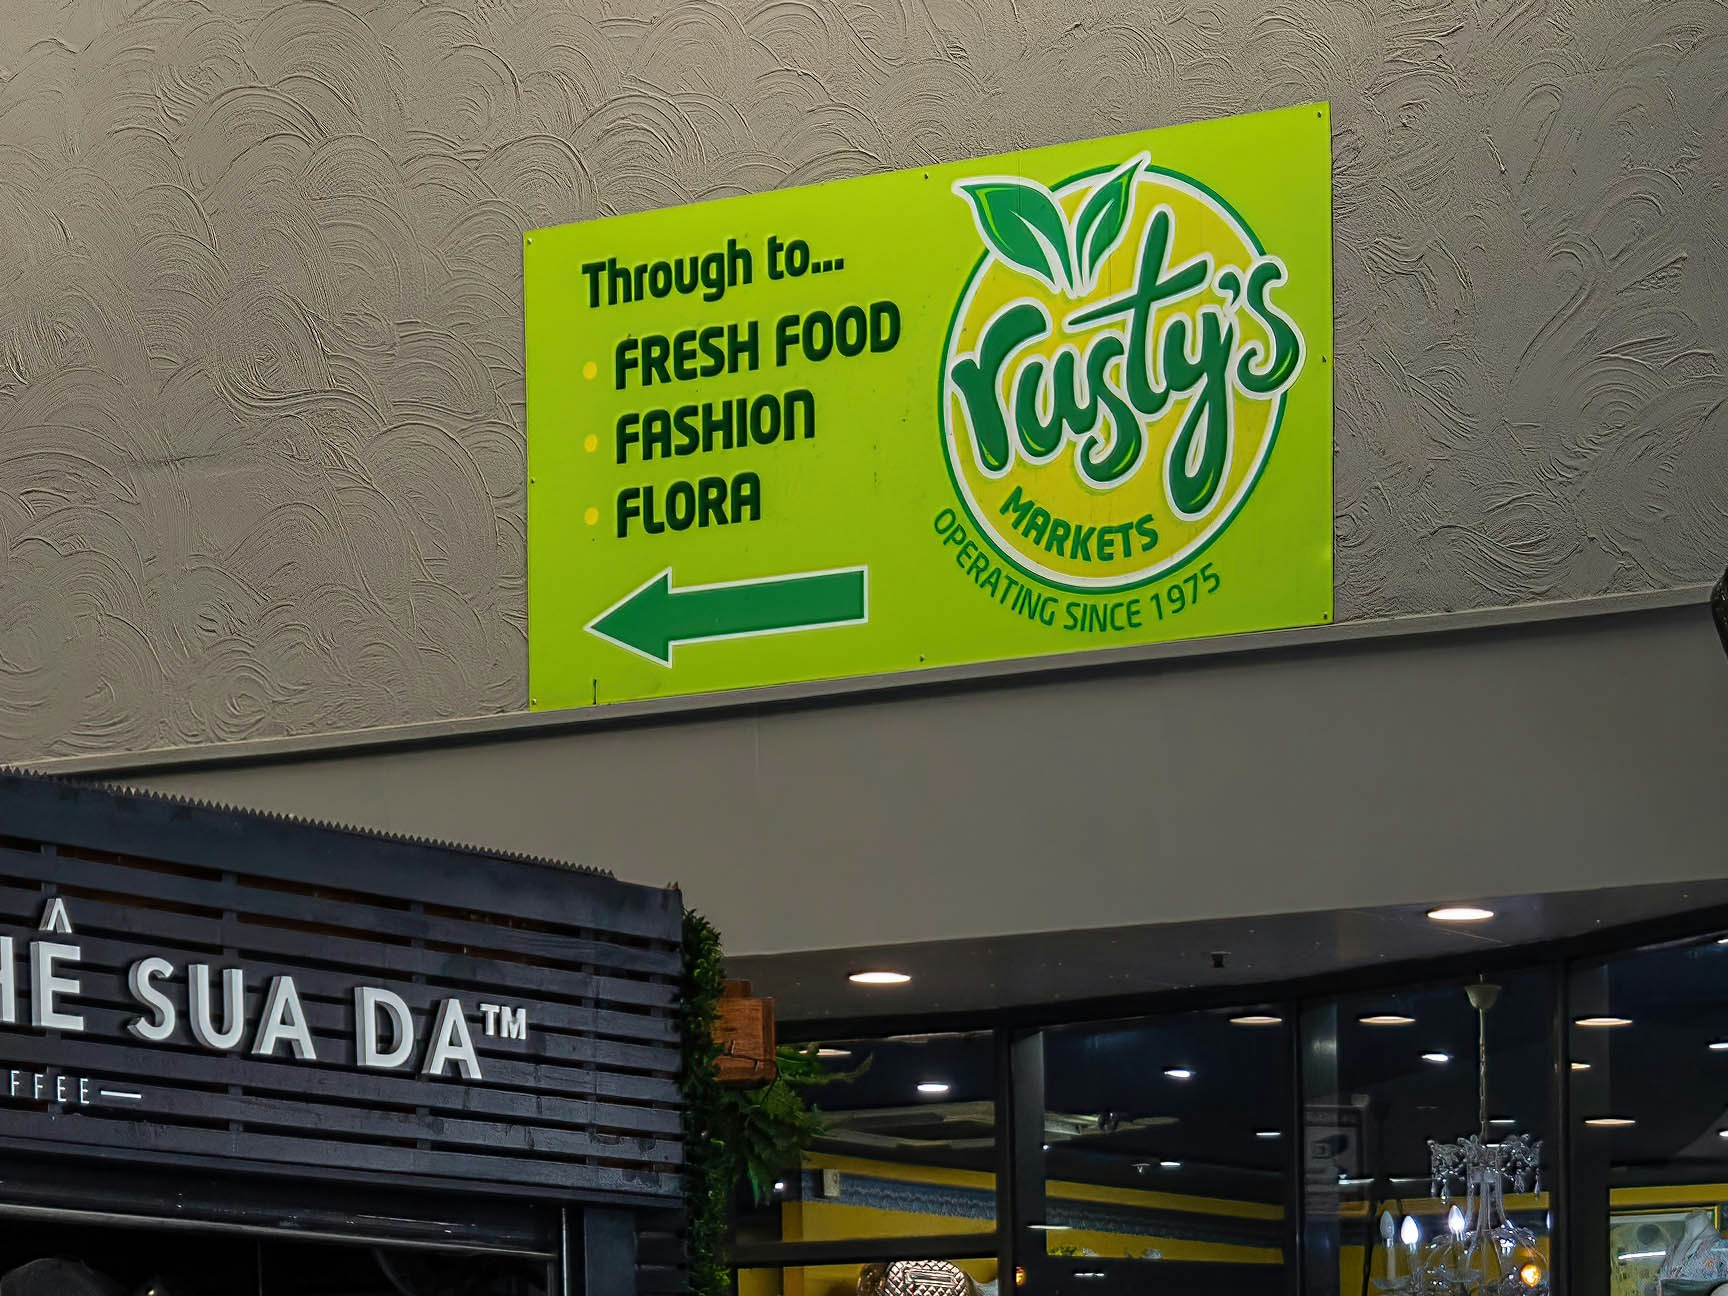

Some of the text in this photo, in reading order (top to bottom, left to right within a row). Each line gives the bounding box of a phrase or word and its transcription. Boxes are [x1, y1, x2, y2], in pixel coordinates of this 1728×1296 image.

[582, 236, 845, 309] Through to...
[614, 299, 901, 390] FRESH FOOD
[952, 205, 1301, 516] rusty's
[615, 388, 817, 465] FASHION
[615, 472, 762, 538] FLORA
[999, 486, 1158, 561] MARKETS
[933, 507, 1223, 633] OPERATING SINCE 1975
[127, 956, 318, 1061] SUA
